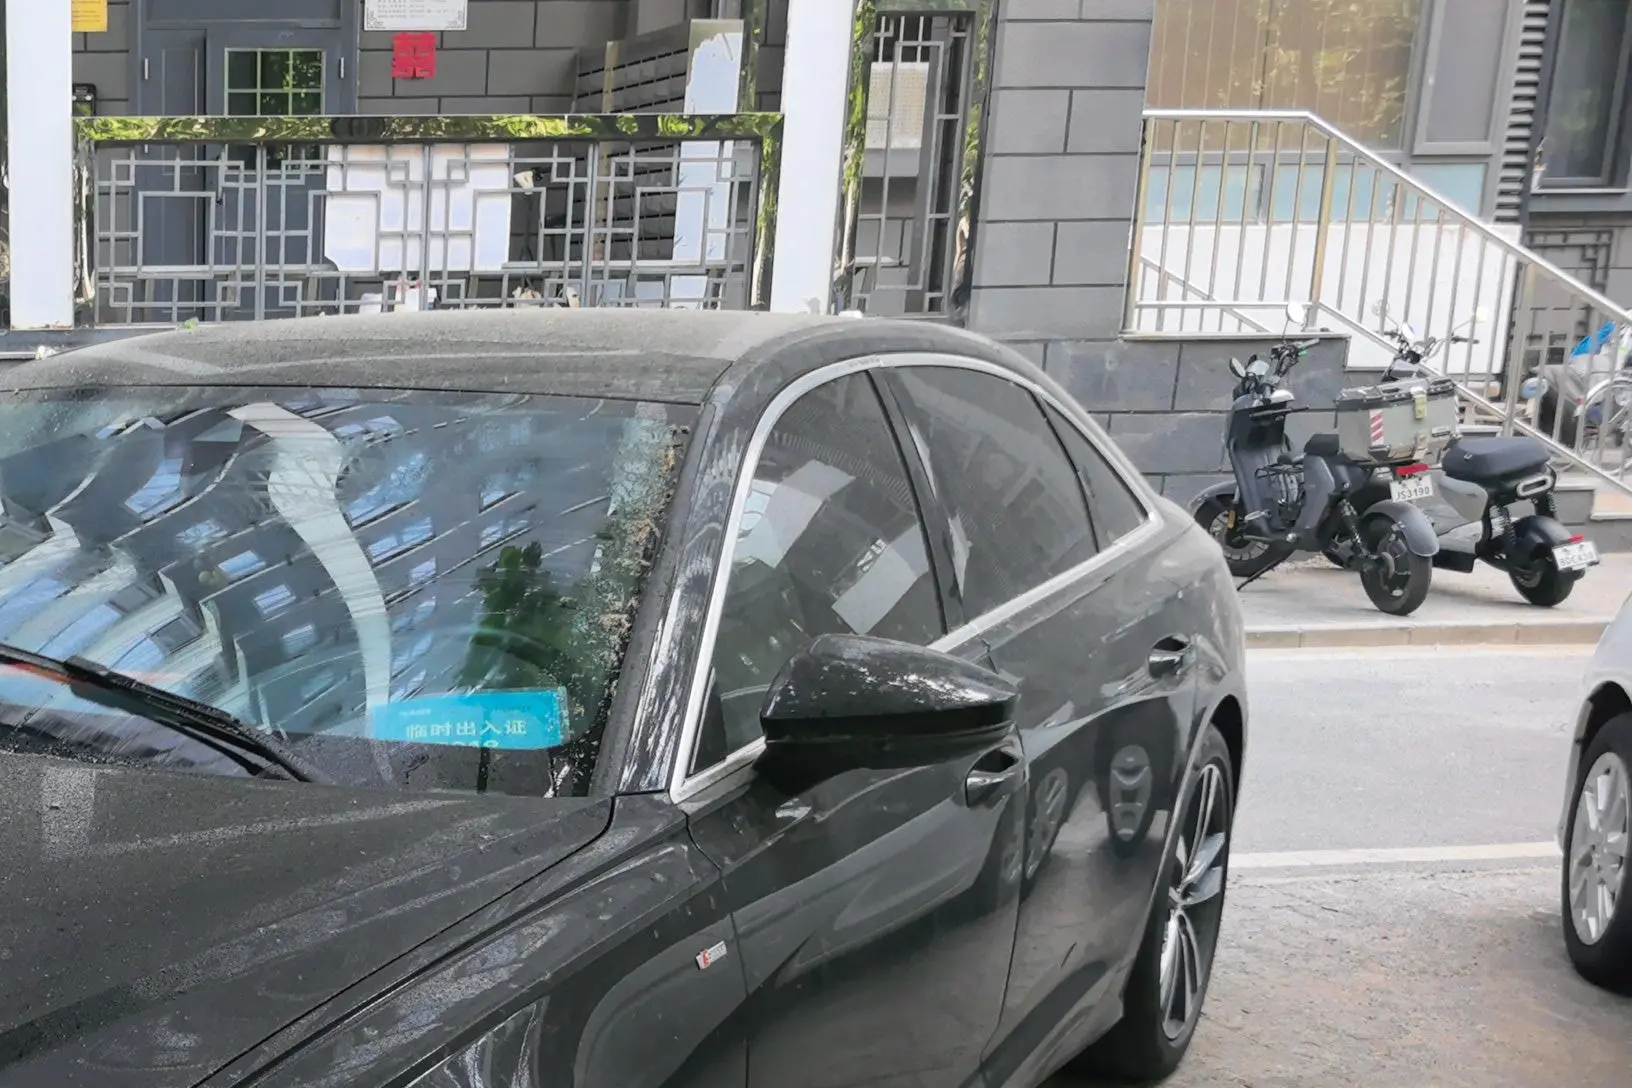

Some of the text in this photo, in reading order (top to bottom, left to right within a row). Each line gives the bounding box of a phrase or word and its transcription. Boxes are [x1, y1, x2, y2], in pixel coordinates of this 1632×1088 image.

[407, 720, 528, 739] 临时出入证
